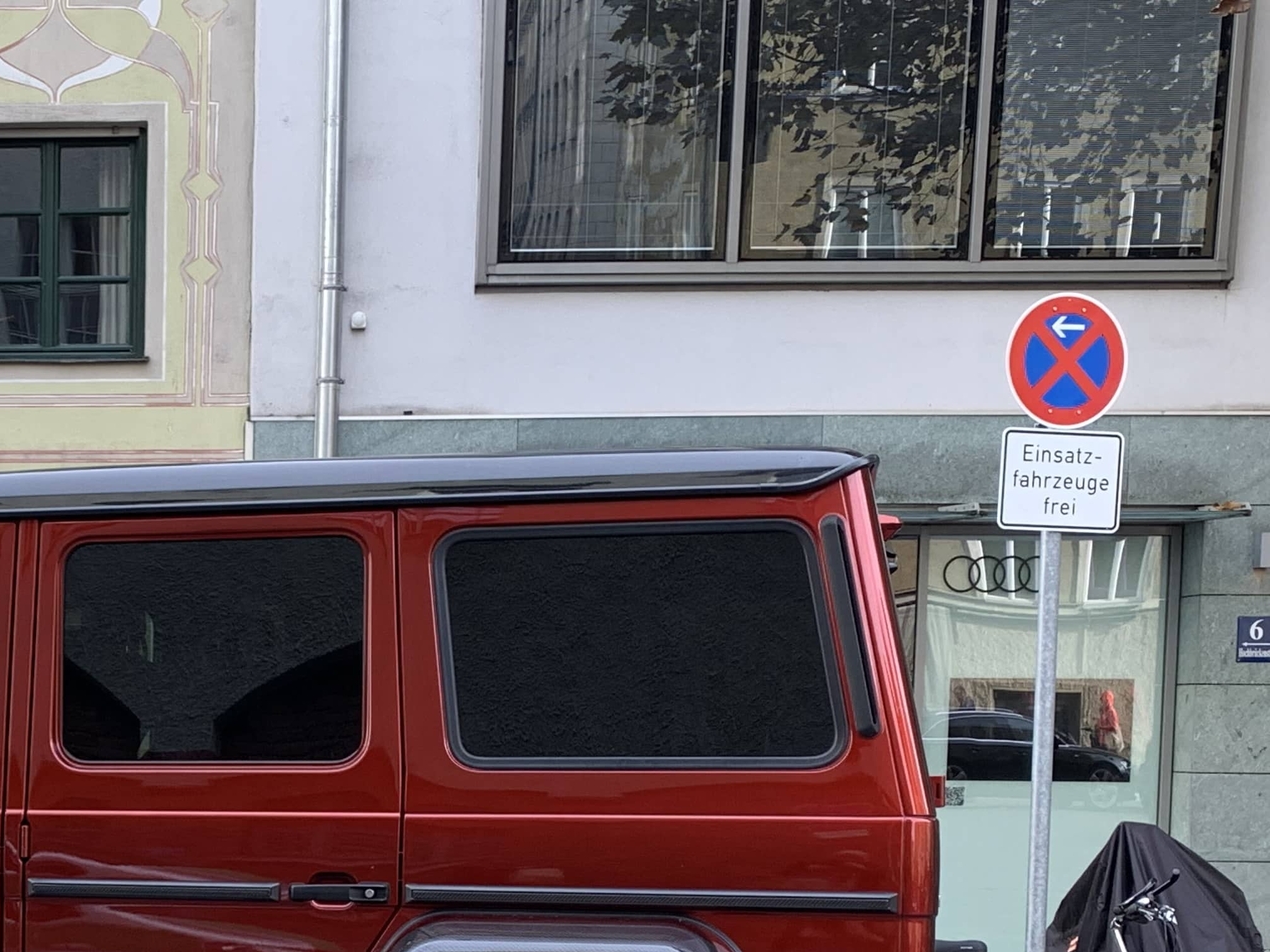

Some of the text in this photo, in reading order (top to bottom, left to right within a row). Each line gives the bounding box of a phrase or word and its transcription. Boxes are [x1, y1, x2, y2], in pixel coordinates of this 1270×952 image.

[1023, 444, 1102, 464] Einsatz-
[1013, 469, 1109, 495] fahrzeuge
[1044, 497, 1076, 515] frei
[1249, 618, 1265, 641] 6
